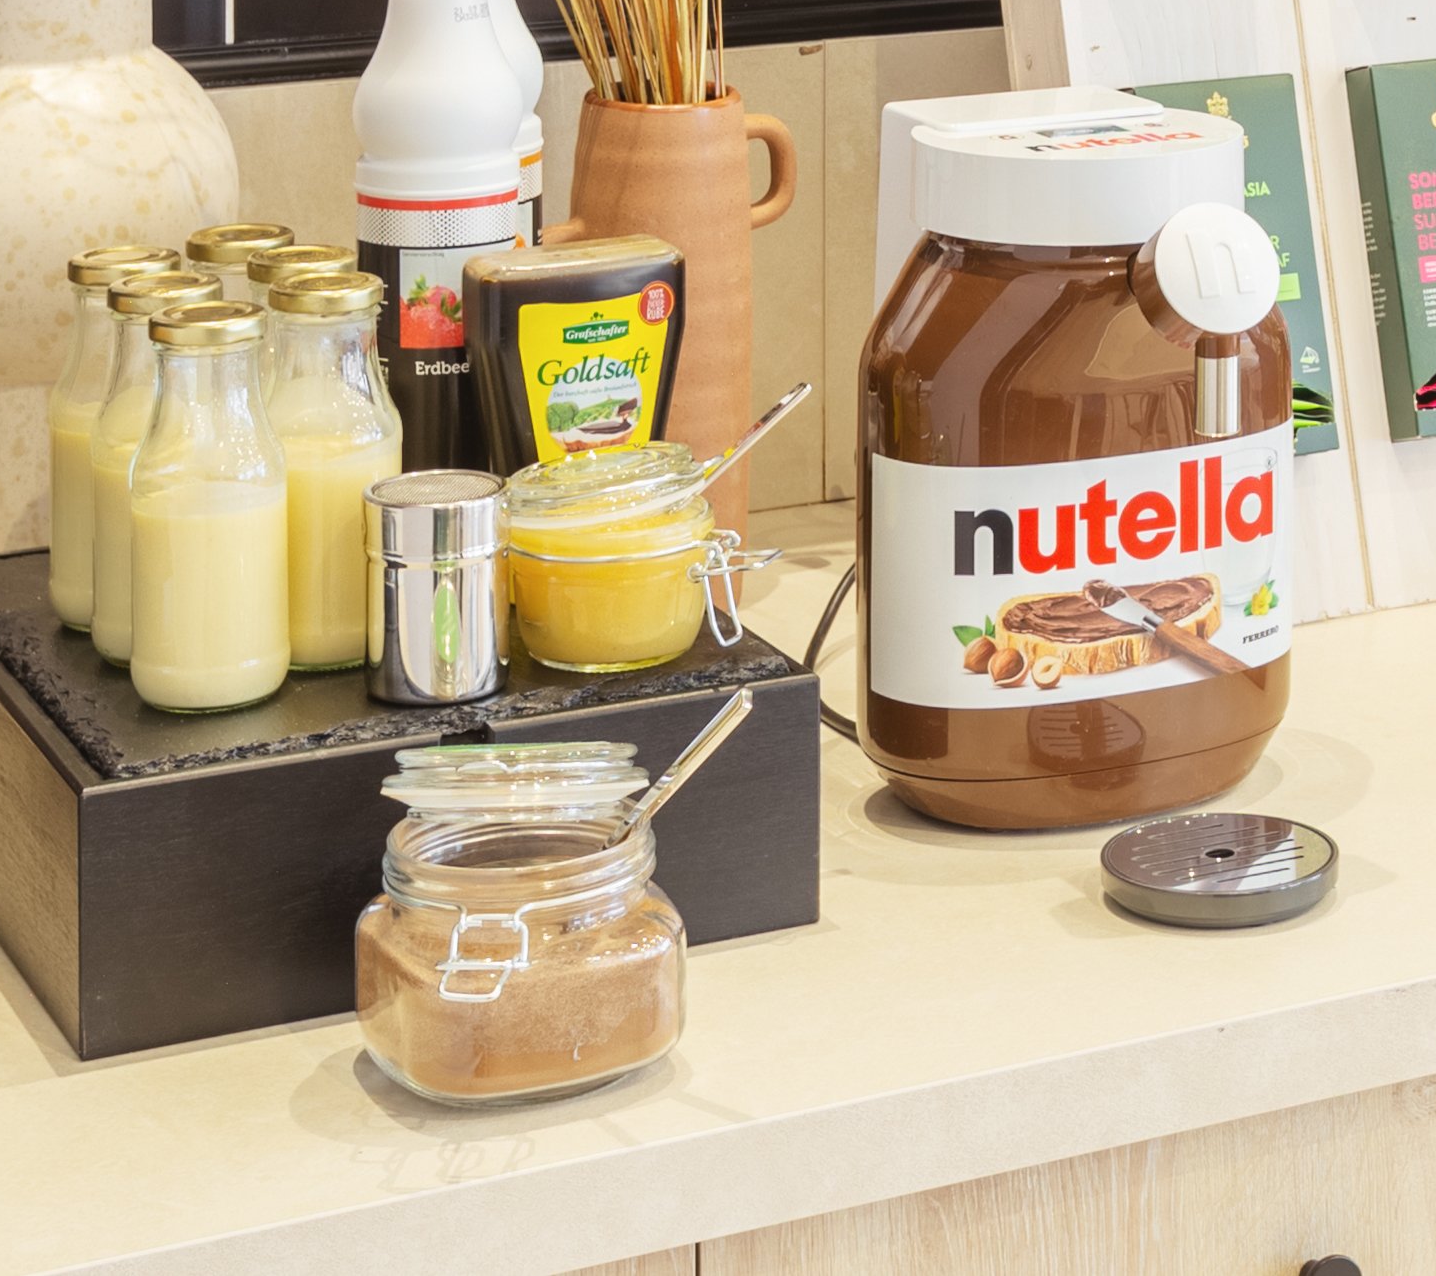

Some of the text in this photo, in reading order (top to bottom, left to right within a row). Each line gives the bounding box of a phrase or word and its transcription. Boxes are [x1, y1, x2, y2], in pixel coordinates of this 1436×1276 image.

[1025, 131, 1204, 152] nutella
[565, 323, 629, 340] Grafschafter
[537, 346, 651, 386] Goldsaft
[953, 455, 1275, 576] nutella
